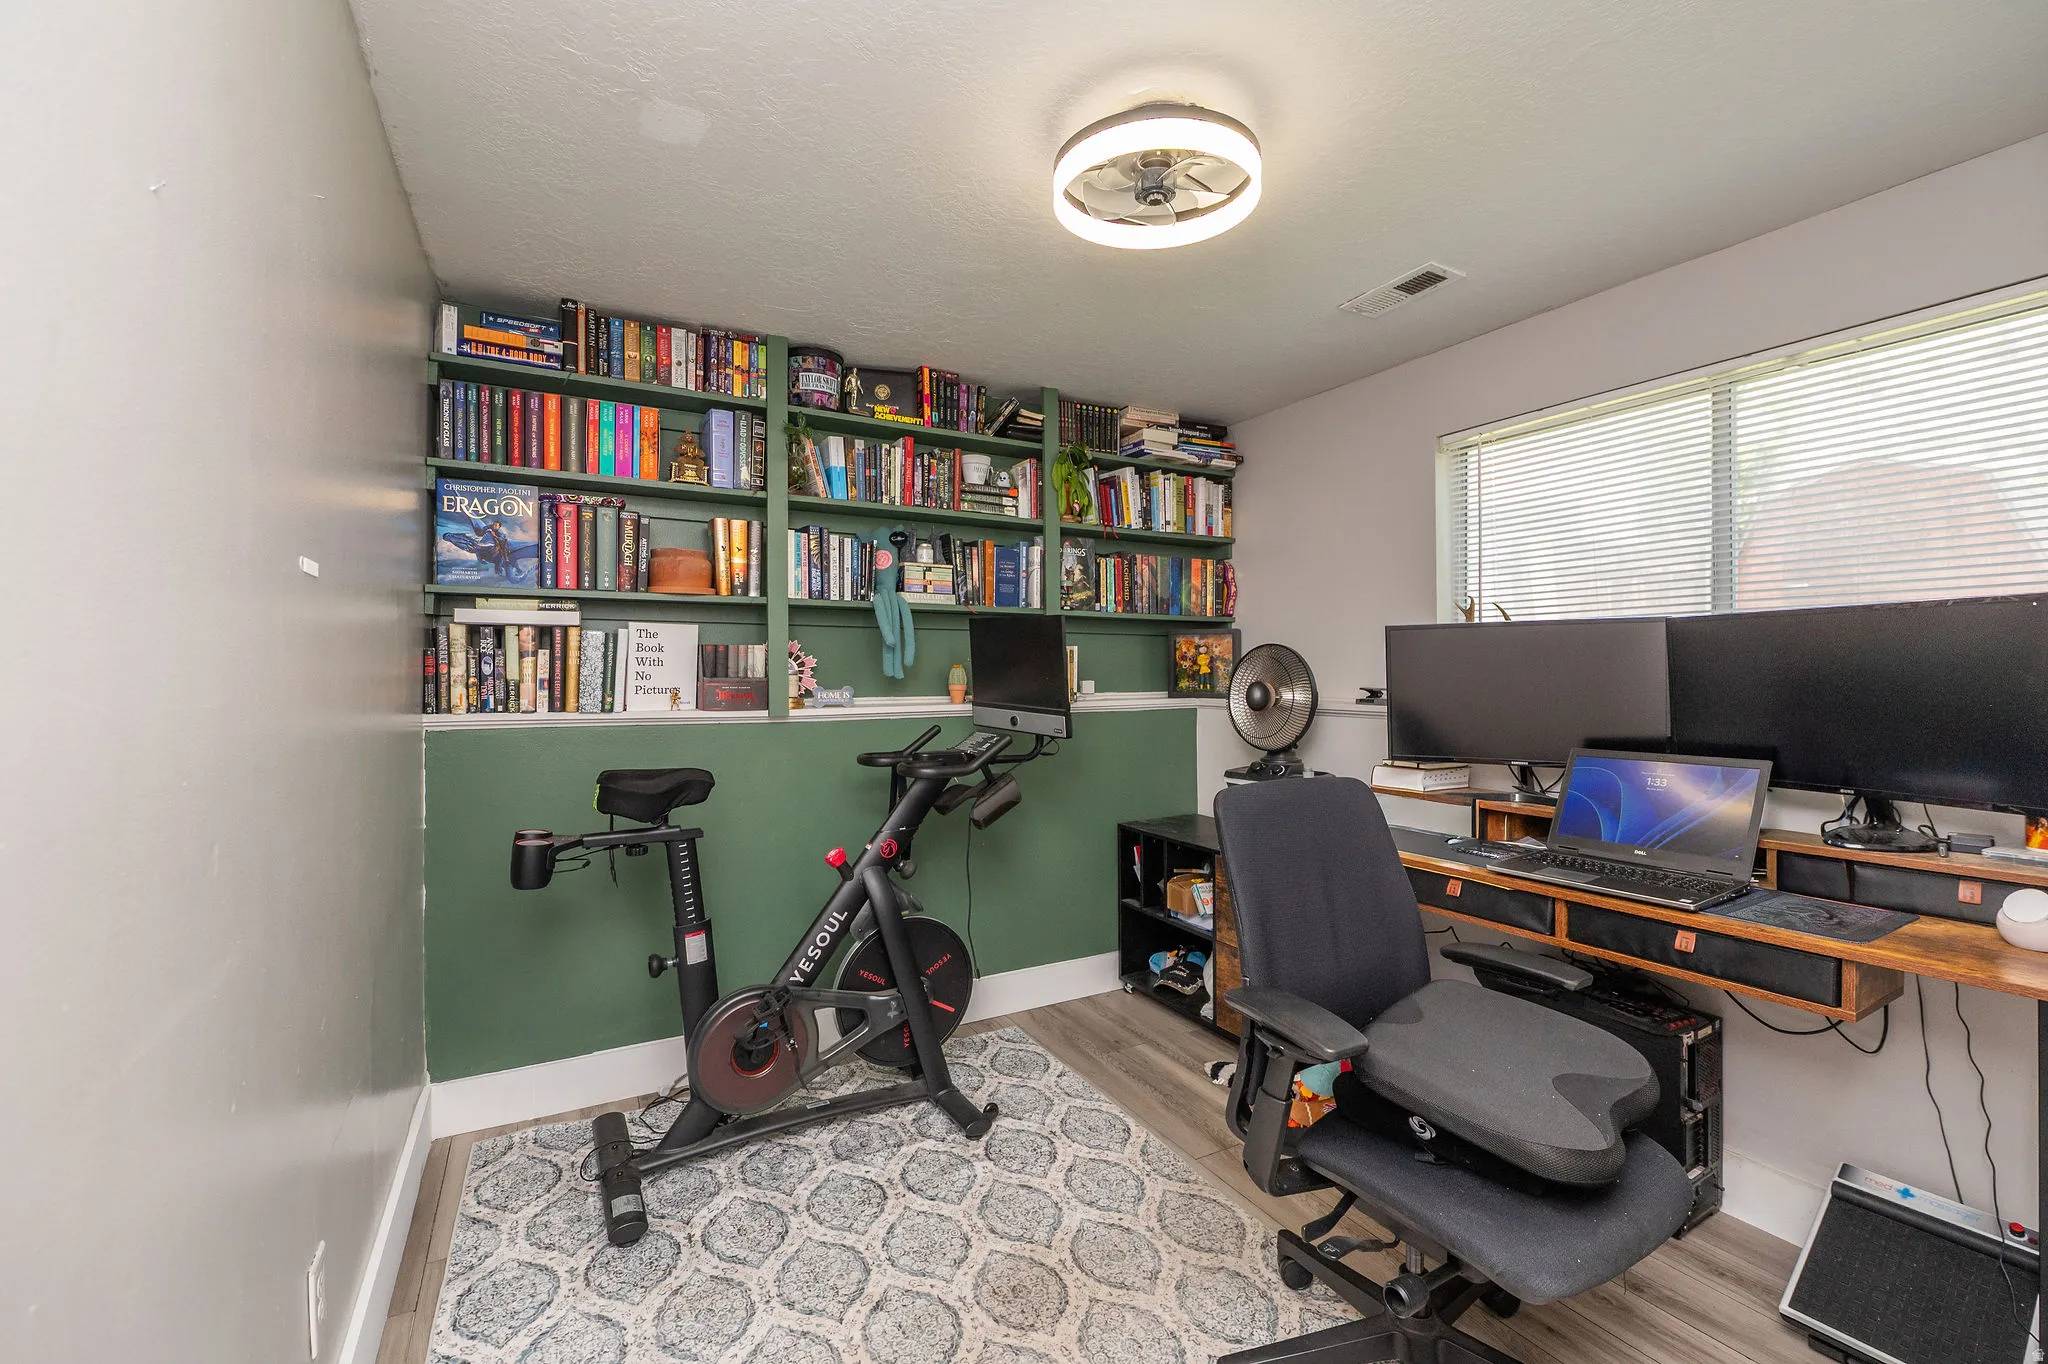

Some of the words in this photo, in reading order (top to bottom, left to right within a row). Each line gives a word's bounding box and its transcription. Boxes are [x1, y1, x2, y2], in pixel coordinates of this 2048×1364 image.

[486, 346, 500, 355] THE
[502, 348, 528, 360] 4-HOUR
[530, 352, 547, 364] BODY
[801, 374, 822, 384] TAYLOR
[874, 405, 890, 414] NEW
[444, 484, 496, 494] CHRISTOPHER
[498, 486, 531, 496] PAOLINI
[442, 495, 534, 519] ERAGON
[544, 518, 553, 563] ERAGON
[563, 520, 572, 564] ELDEST
[622, 525, 636, 567] MURTAGH
[636, 628, 659, 639] The
[636, 643, 664, 653] Book
[438, 652, 448, 664] RICE
[635, 656, 664, 667] With
[634, 671, 652, 681] No
[1647, 777, 1668, 787] 1:33
[789, 912, 848, 984] YESOUL
[925, 953, 952, 976] YESOUL
[858, 969, 886, 986] YESOUL
[1864, 1176, 1893, 1191] med
